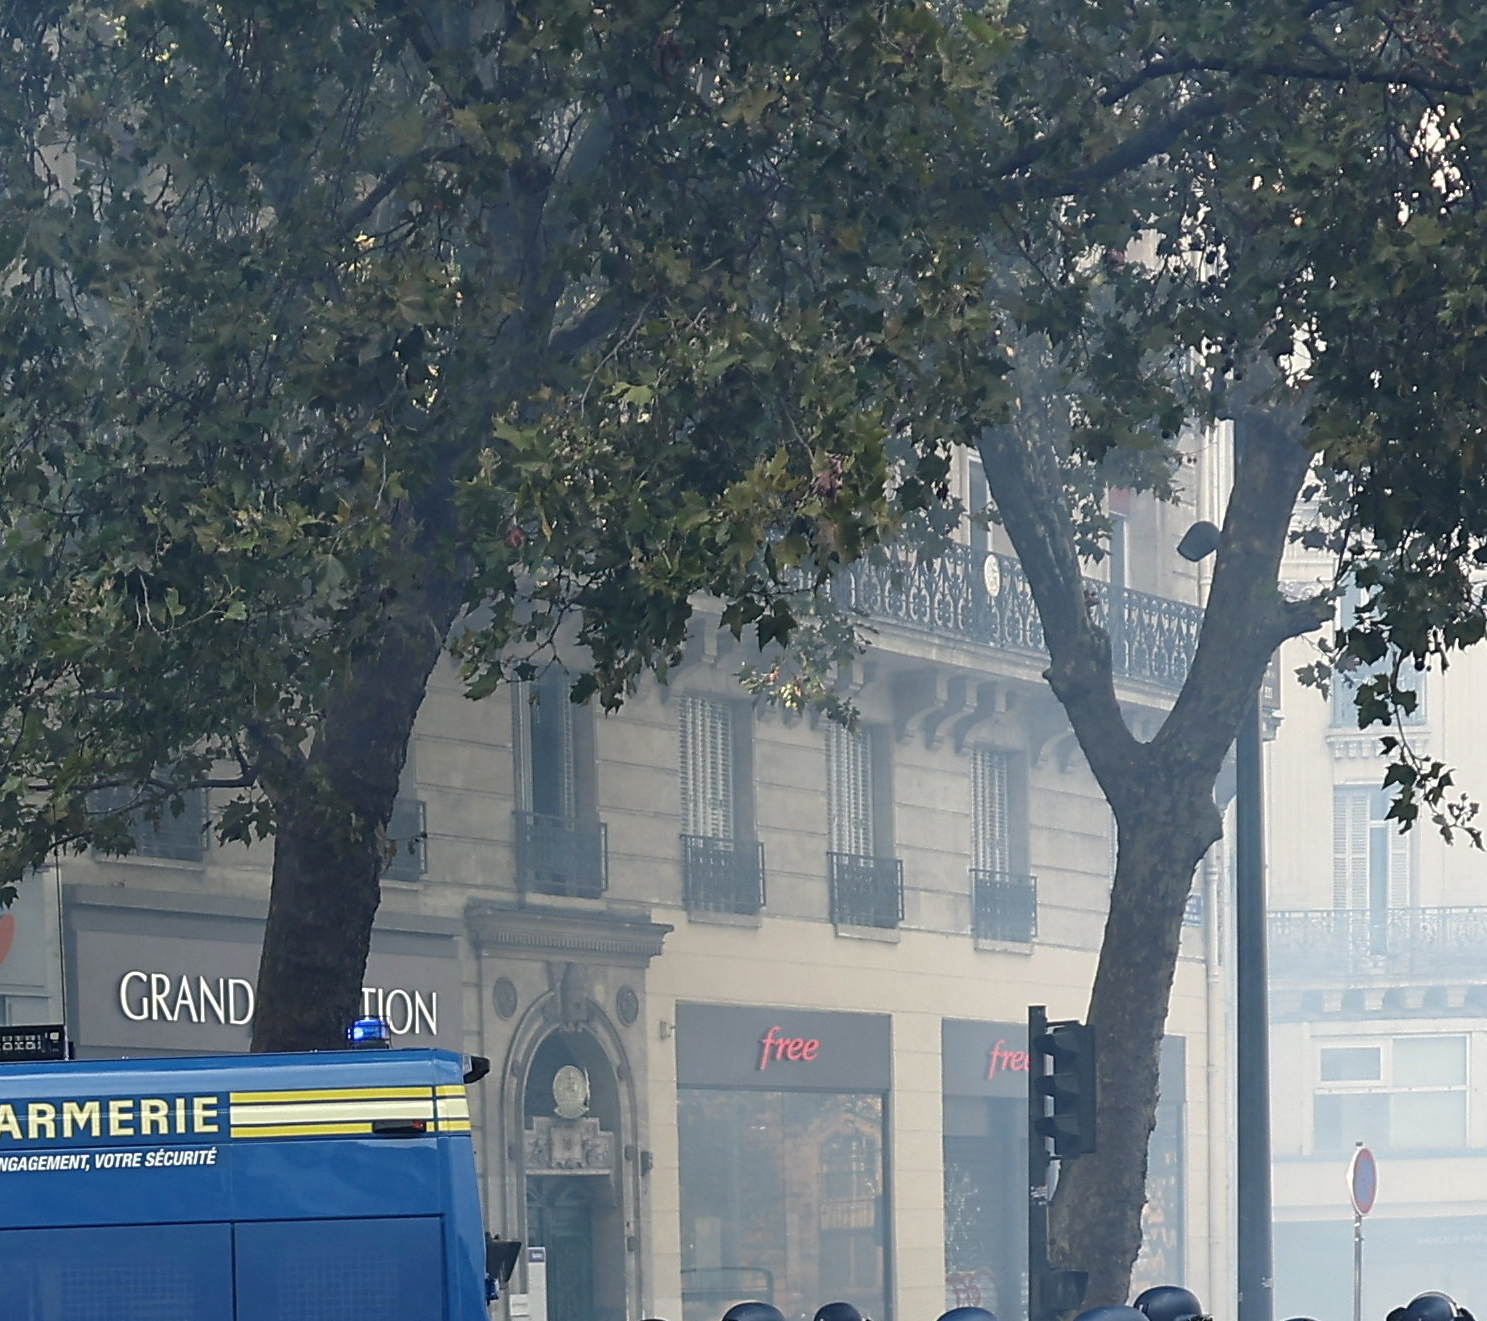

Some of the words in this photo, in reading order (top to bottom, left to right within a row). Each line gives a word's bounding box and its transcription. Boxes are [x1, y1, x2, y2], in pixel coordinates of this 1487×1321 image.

[119, 969, 255, 1026] GRAND
[361, 985, 438, 1036] TION
[759, 1025, 820, 1071] free
[93, 1151, 142, 1168] VOTRE
[144, 1146, 218, 1167] SÉCURITÉ
